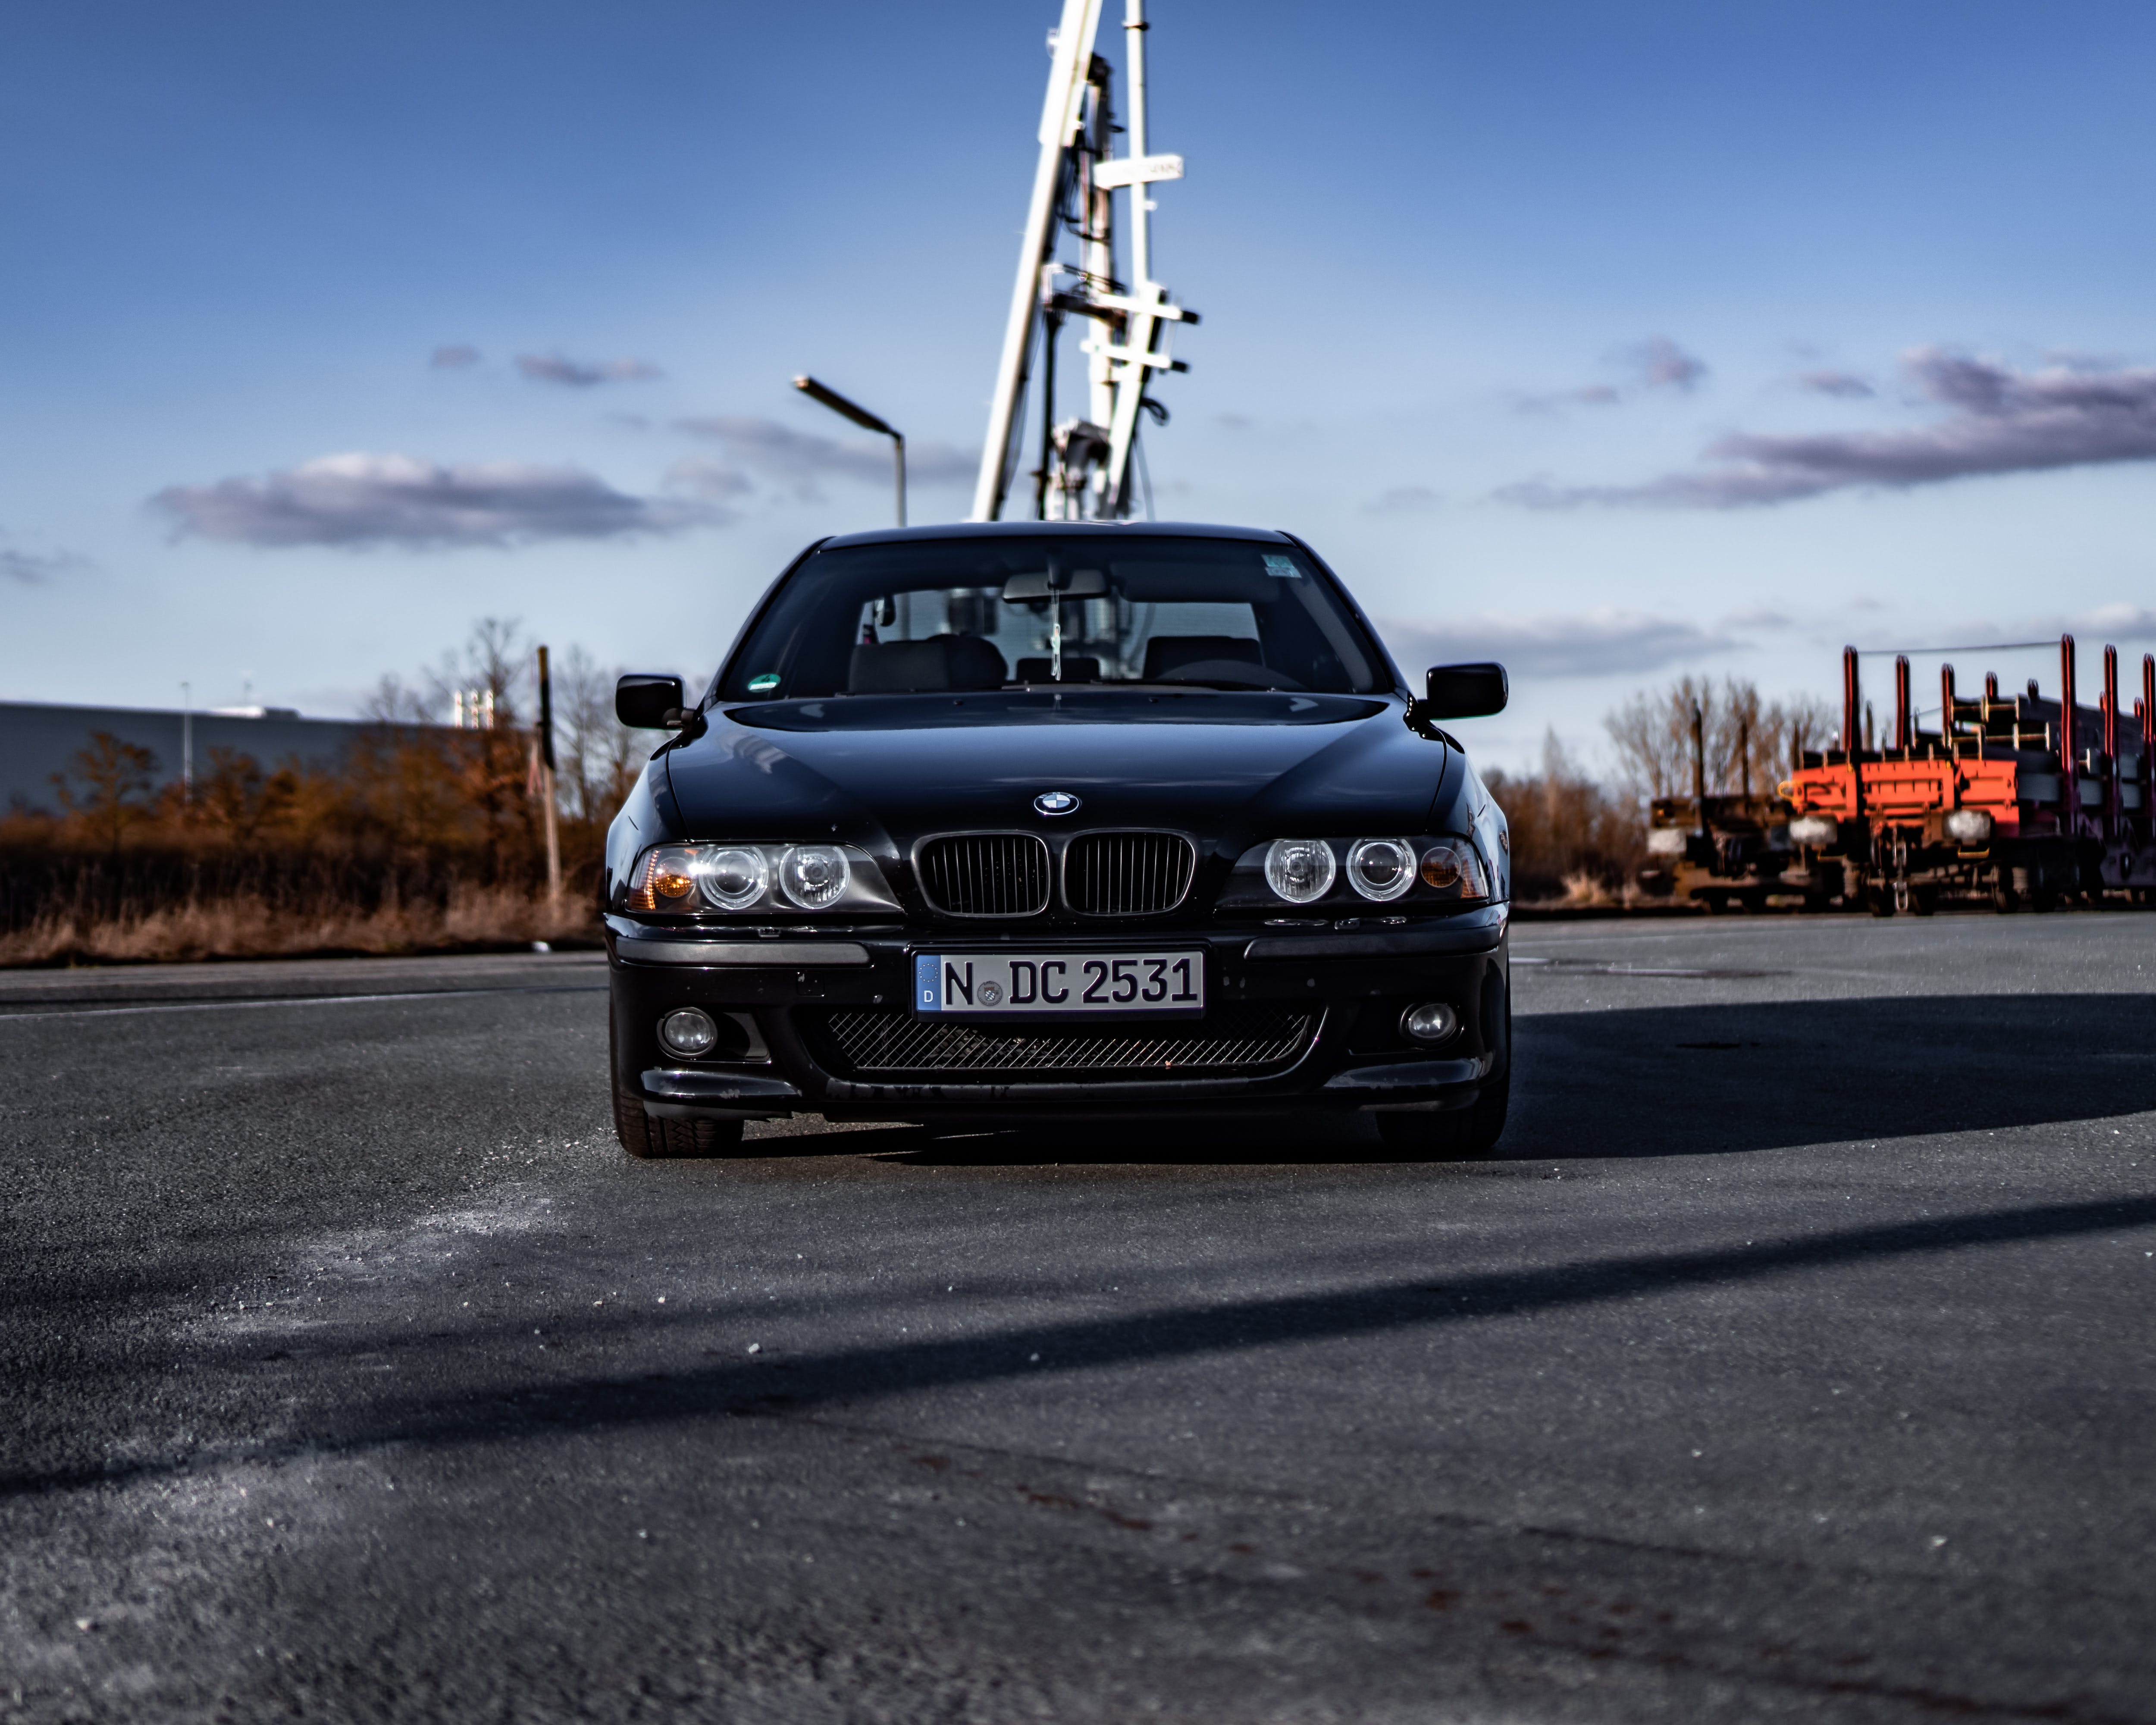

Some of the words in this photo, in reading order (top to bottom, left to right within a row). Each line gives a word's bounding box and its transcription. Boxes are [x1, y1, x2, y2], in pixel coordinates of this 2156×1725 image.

[924, 990, 933, 1002] D
[945, 961, 974, 1005] N
[1009, 961, 1069, 1004] DC
[1082, 958, 1197, 1003] 2531
